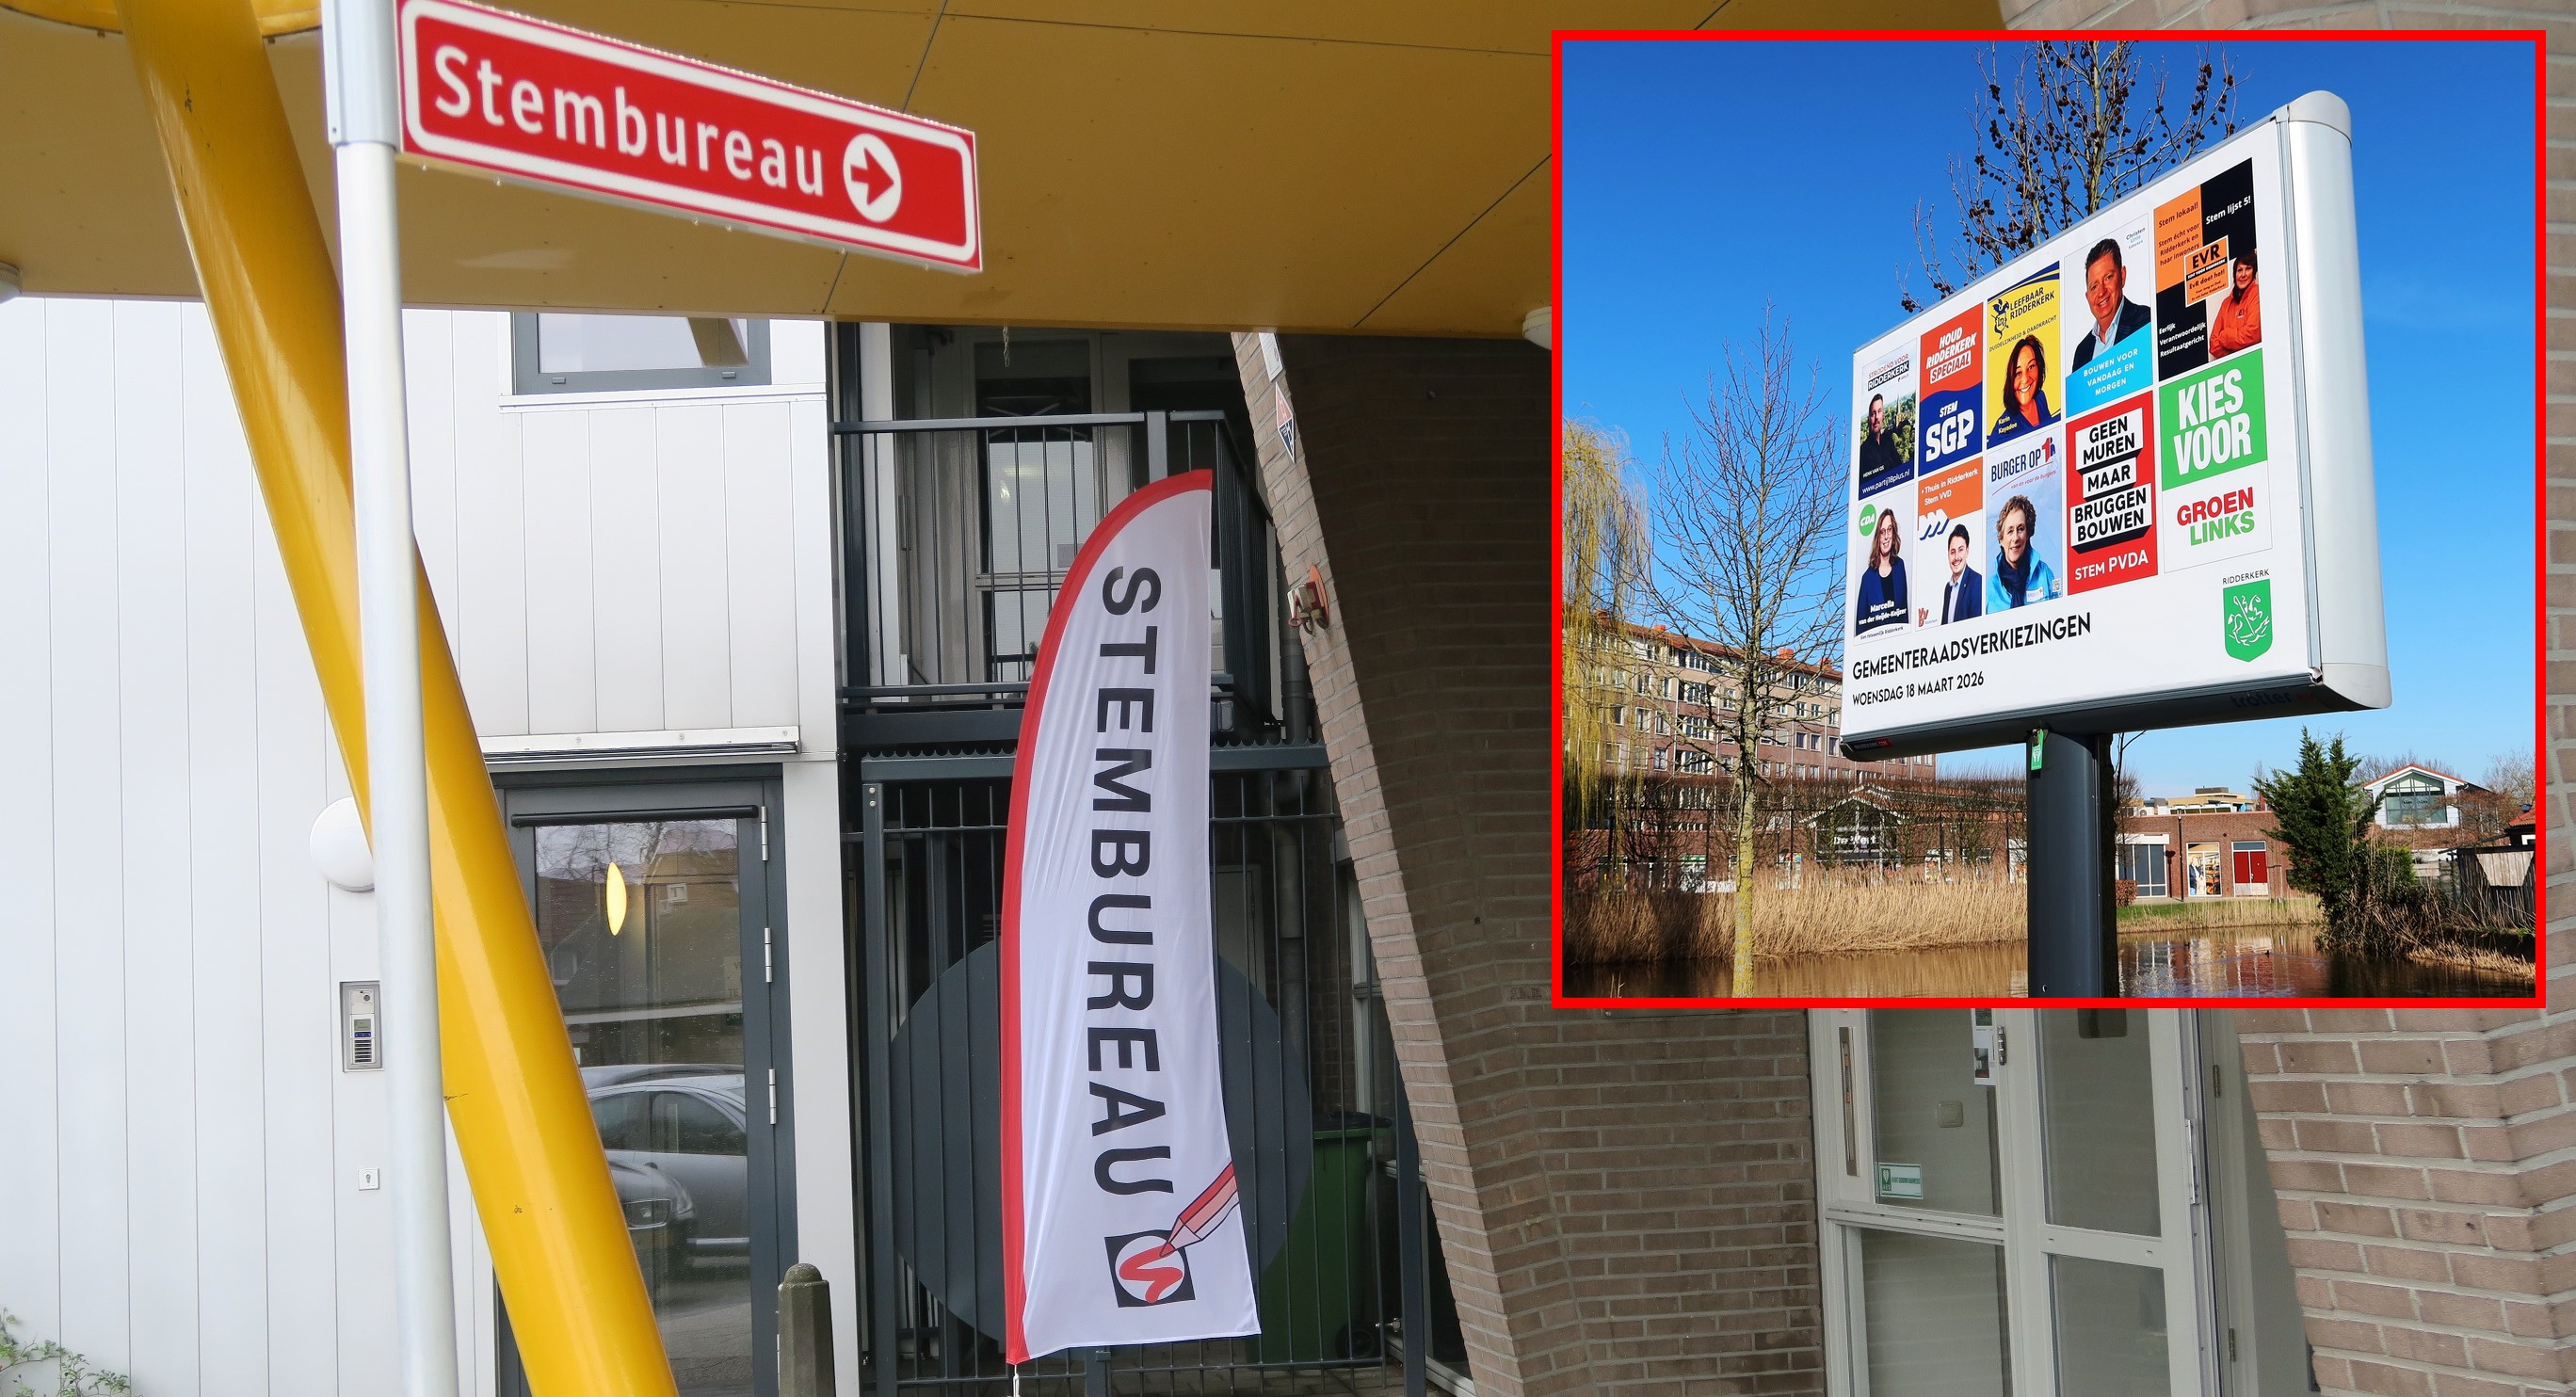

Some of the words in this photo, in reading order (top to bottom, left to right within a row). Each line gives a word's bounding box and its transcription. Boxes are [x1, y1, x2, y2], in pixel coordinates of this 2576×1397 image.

[433, 45, 824, 198] Stembureau
[2158, 215, 2175, 228] Stem
[2176, 201, 2198, 219] lokaal!
[2205, 209, 2226, 225] Stem
[2227, 201, 2243, 215] lijst
[2243, 195, 2251, 205] 5!
[2126, 227, 2145, 240] Christen
[2158, 237, 2172, 248] Stem
[2186, 223, 2199, 233] voor
[2160, 237, 2190, 256] Ridderkerk
[2191, 233, 2199, 242] en
[2160, 256, 2172, 266] haar
[2173, 243, 2199, 262] inwoners
[2192, 244, 2220, 269] EVR
[2199, 274, 2214, 285] doet
[2214, 269, 2226, 279] het!
[2010, 287, 2044, 311] LEEFBAAR
[2010, 290, 2055, 320] RIDDERKERK
[2026, 314, 2057, 333] DAADKRACHT
[2158, 322, 2176, 335] Eerlijk
[2159, 321, 2206, 346] Verantwoordelijk
[1925, 331, 1978, 370] RIDDERKERK
[1939, 326, 1963, 349] HOUD
[2160, 334, 2205, 358] Resultaatgericht
[1893, 353, 1909, 366] VOOR
[1931, 352, 1970, 382] SPECIAAL
[2083, 359, 2115, 377] BOUWEN
[2116, 347, 2139, 364] VOOR
[1868, 361, 1909, 391] RIDDERKERK
[2086, 366, 2122, 388] VANDAAG
[2124, 361, 2134, 374] EN
[2095, 378, 2127, 397] MORGEN
[1939, 400, 1958, 418] STEM
[2178, 368, 2244, 431] KIES
[1998, 416, 2011, 425] Karin
[2088, 415, 2128, 443] GEEN
[1925, 409, 1975, 462] SGP
[2083, 432, 2135, 465] MUREN
[2173, 412, 2253, 475] VOOR
[1990, 454, 2027, 482] BURGER
[2029, 448, 2041, 469] OP
[2087, 464, 2131, 492] MAAR
[1861, 468, 1910, 494] www.partij18plus.nl
[1924, 482, 1940, 494] Thuis
[1940, 480, 1947, 489] in
[1946, 467, 1978, 486] Ridderkerk
[1924, 495, 1939, 506] Stem
[1939, 489, 1952, 500] VVD
[2074, 487, 2147, 523] BRUGGEN
[2177, 486, 2254, 526] GROEN
[1860, 512, 1876, 527] CDA
[2077, 508, 2144, 542] BOUWEN
[2189, 510, 2255, 547] LINKS
[2074, 561, 2105, 581] STEM
[2108, 549, 2149, 572] PVDA
[2222, 568, 2270, 586] RIDDERKERK
[1866, 615, 1876, 623] der
[1875, 608, 1908, 621] Heijde-Keijzer
[1870, 600, 1895, 613] Marcella
[1852, 611, 2091, 681] GEMEENTERAADSVERKIEZINGEN
[1852, 684, 1904, 706] WOENSDAG
[1906, 682, 1915, 698] 18
[1917, 676, 1955, 697] MAART
[1956, 670, 1985, 690] 2026
[1084, 564, 1175, 1196] STEMBUREAU
